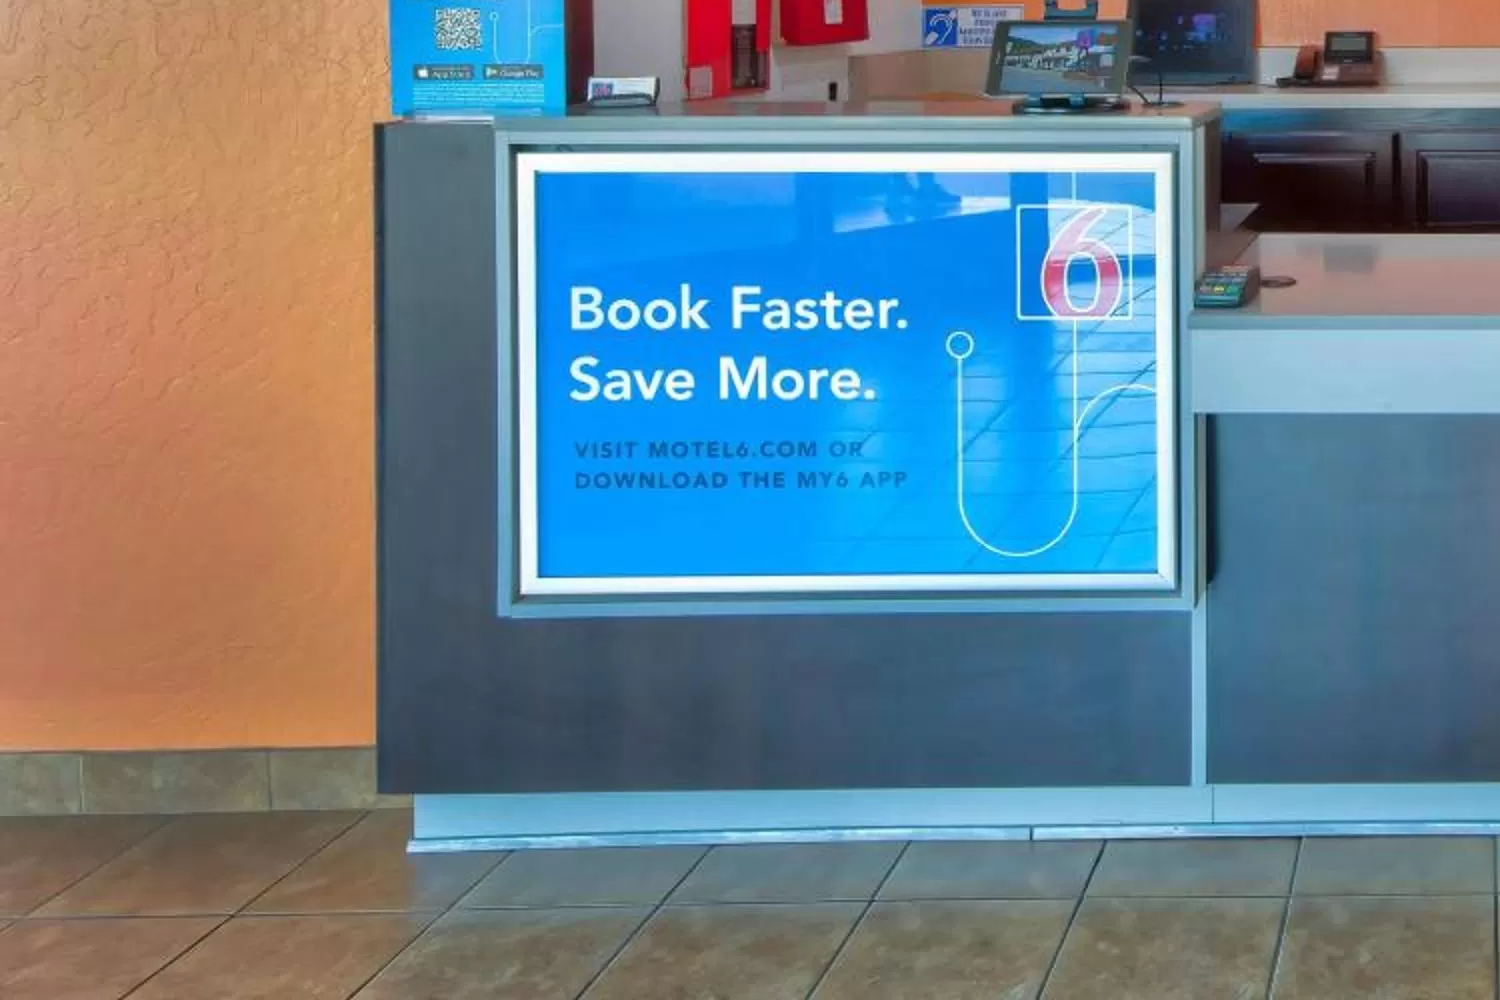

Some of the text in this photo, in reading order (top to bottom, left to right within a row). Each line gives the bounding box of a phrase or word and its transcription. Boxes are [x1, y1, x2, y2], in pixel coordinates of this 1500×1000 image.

[1041, 205, 1123, 319] 6
[570, 283, 908, 330] Book Faster.
[569, 355, 876, 401] Save More.
[574, 441, 864, 458] VISIT MOTEL6.COM OR
[575, 471, 908, 489] DOWNLOAD THE MY6 APP
